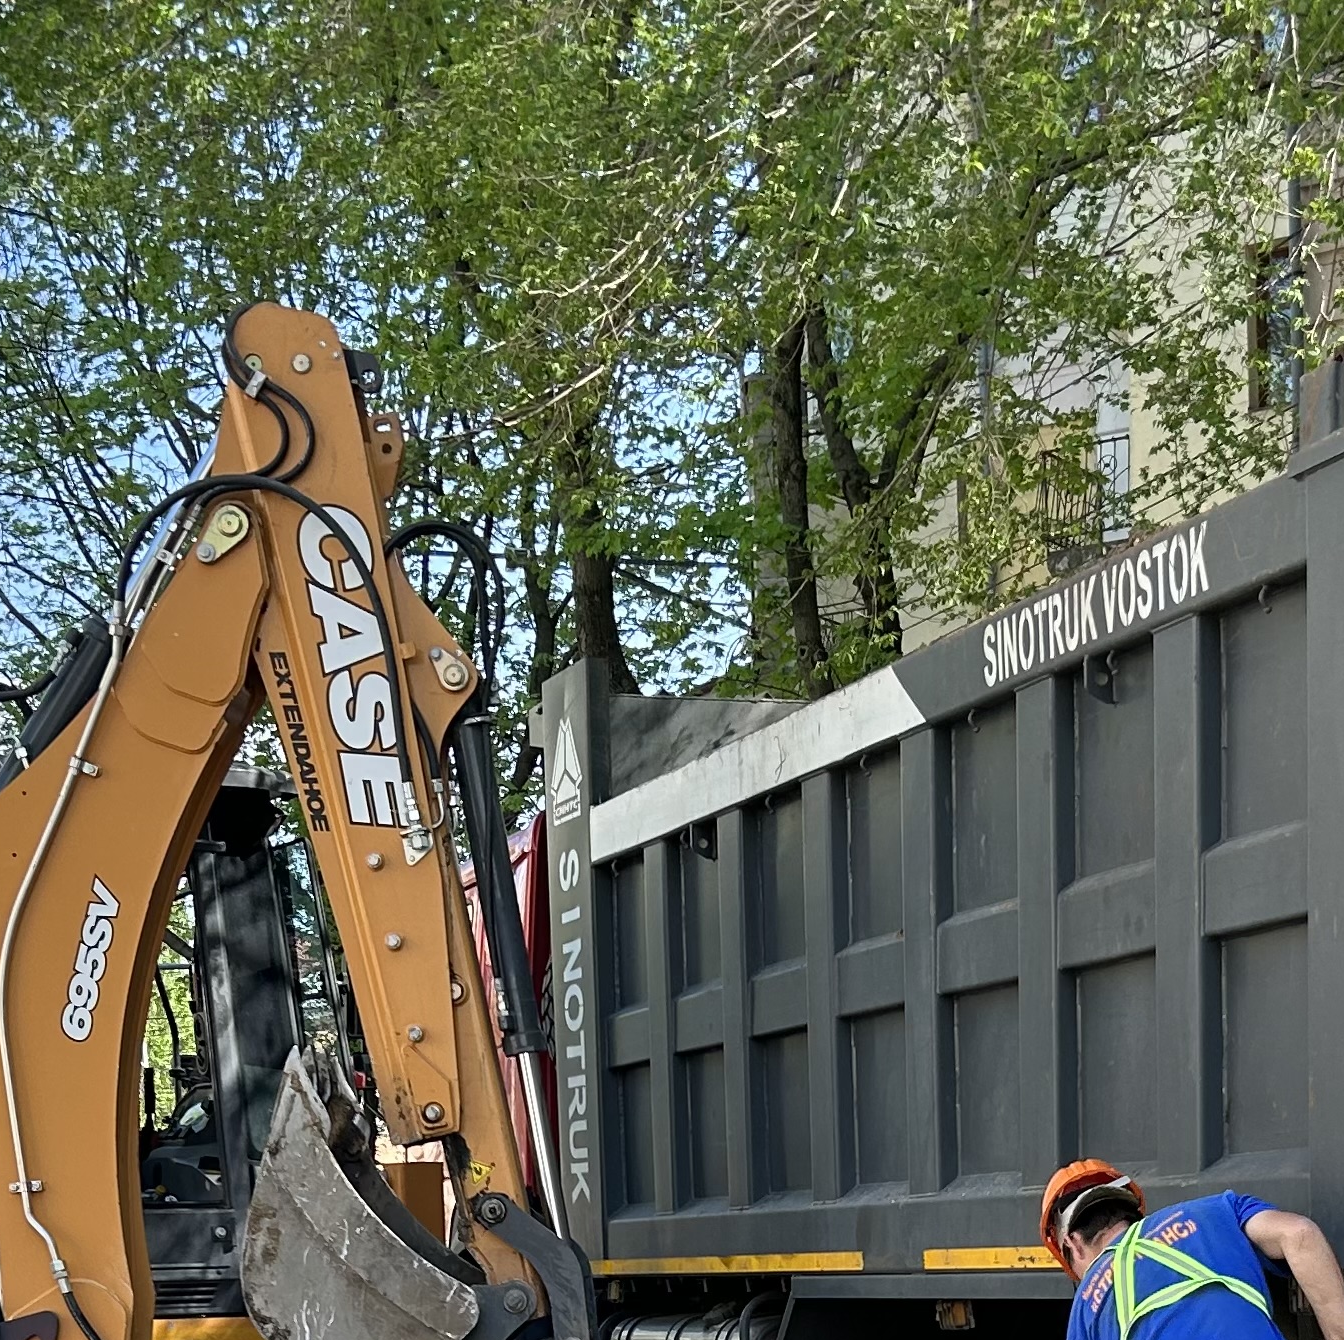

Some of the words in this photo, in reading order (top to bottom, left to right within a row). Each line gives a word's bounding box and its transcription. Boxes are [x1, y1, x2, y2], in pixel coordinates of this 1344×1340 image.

[298, 503, 412, 828] CASE
[983, 574, 1098, 687] SINOTRUK
[1101, 521, 1210, 634] VOSTOK
[269, 651, 330, 832] EXTENDAHOE
[61, 874, 120, 1042] 695SV
[559, 849, 591, 1204] SINOTRUK
